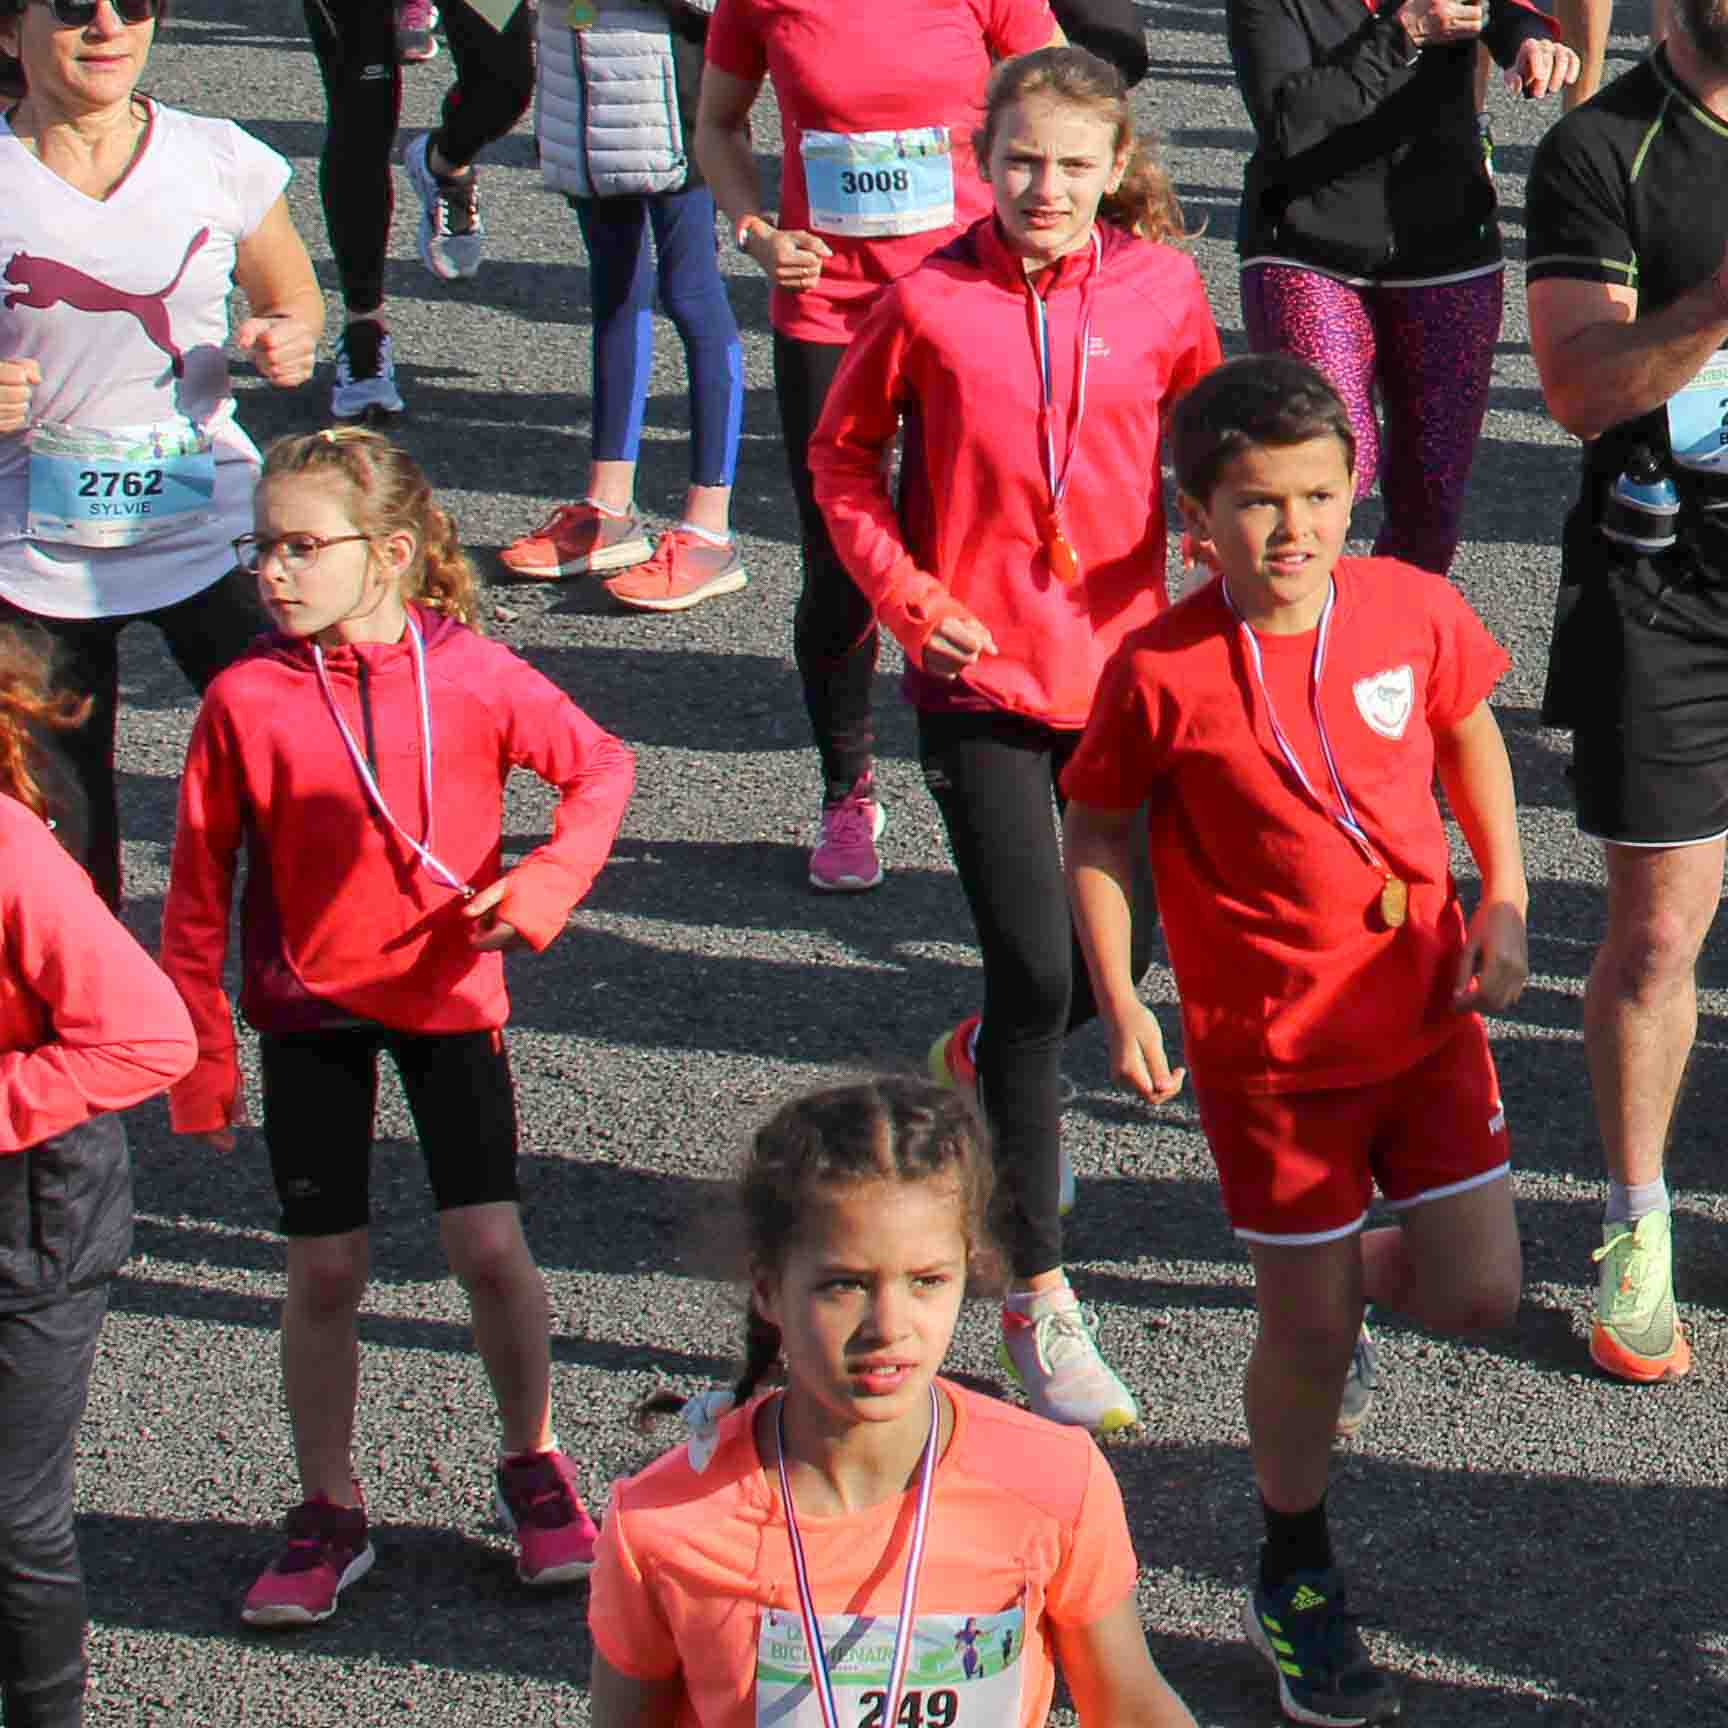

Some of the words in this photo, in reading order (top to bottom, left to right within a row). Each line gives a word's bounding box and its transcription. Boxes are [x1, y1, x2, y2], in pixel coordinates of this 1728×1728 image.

[842, 168, 909, 194] 3008
[79, 470, 163, 498] 2762
[89, 501, 153, 515] SYLVIE
[858, 1690, 959, 1728] 249
